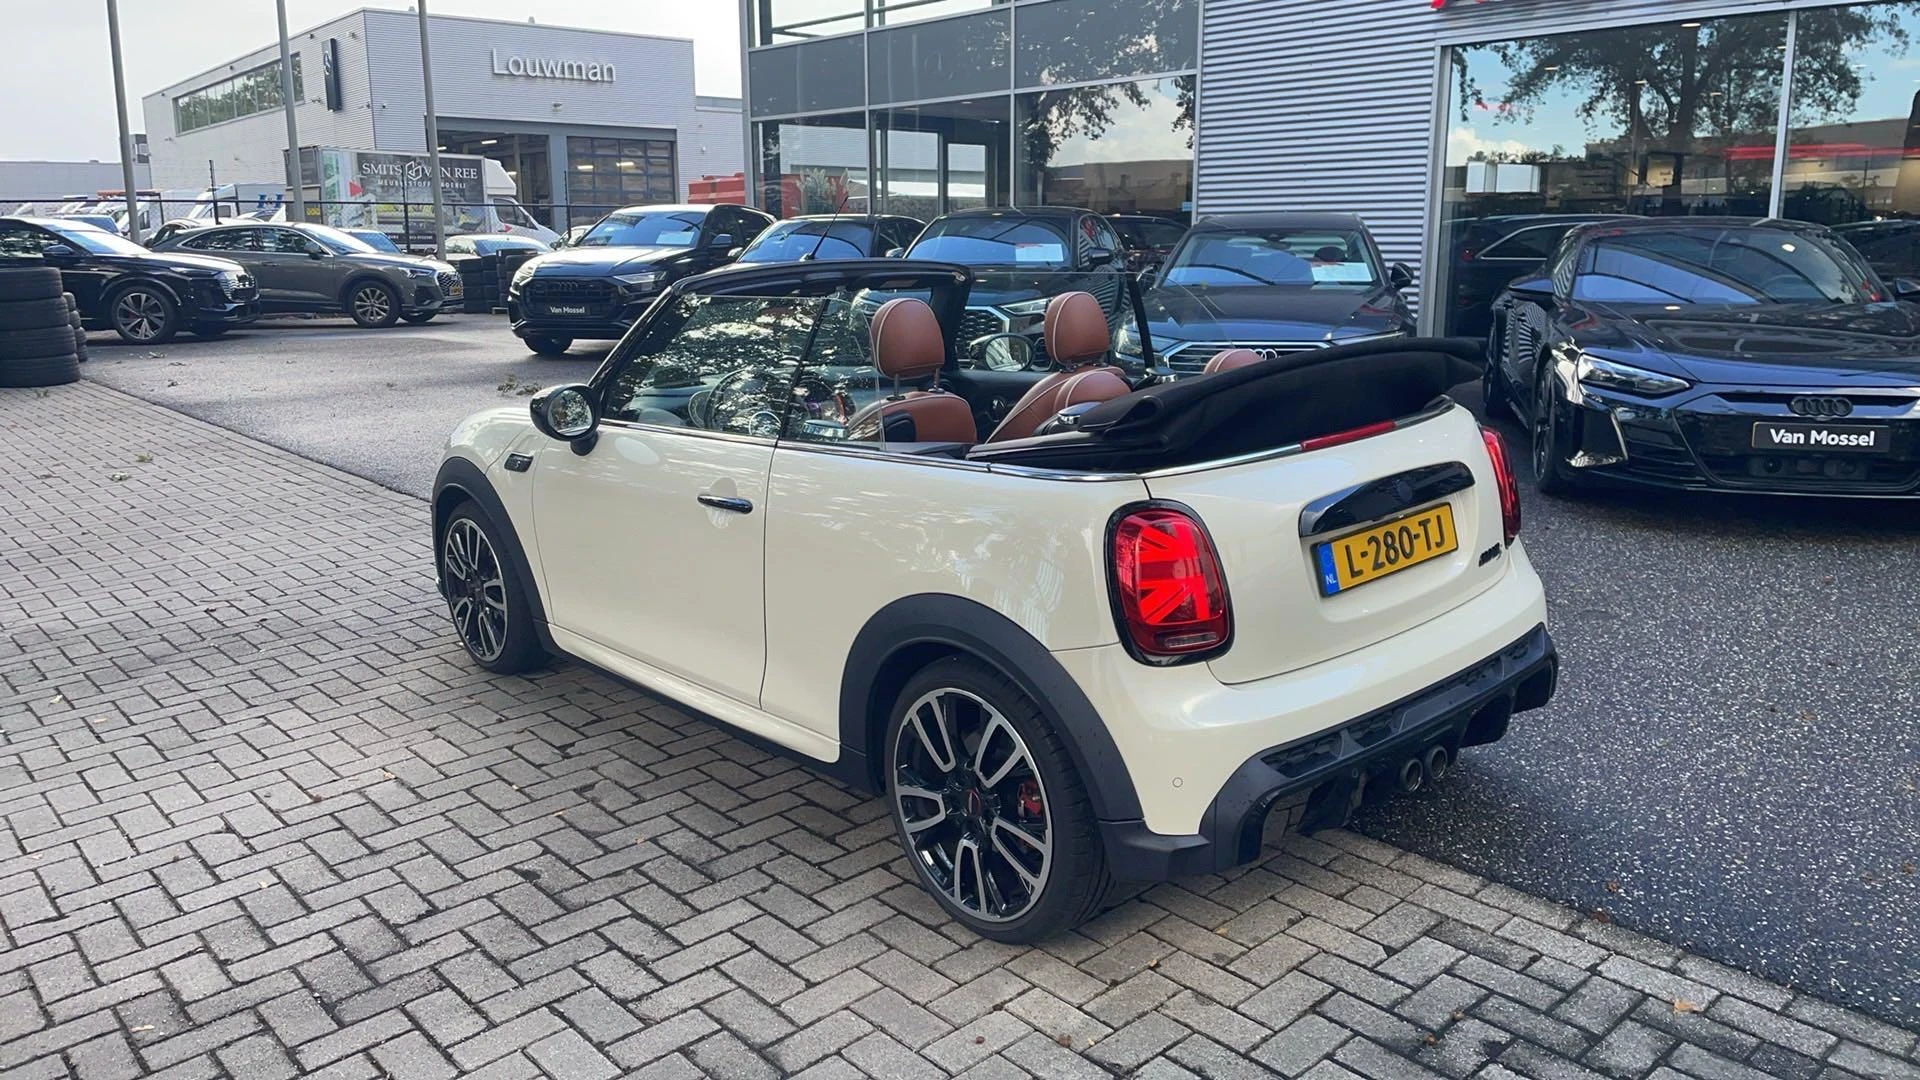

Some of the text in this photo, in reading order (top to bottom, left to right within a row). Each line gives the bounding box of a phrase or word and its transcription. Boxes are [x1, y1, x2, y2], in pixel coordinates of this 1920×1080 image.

[492, 48, 617, 82] Louwman
[362, 162, 479, 180] SMITS VN REE
[550, 306, 585, 314] Van Mossel
[1769, 428, 1875, 446] Van Mossel
[1344, 514, 1446, 579] L-280-TJ
[1325, 574, 1337, 585] NL
